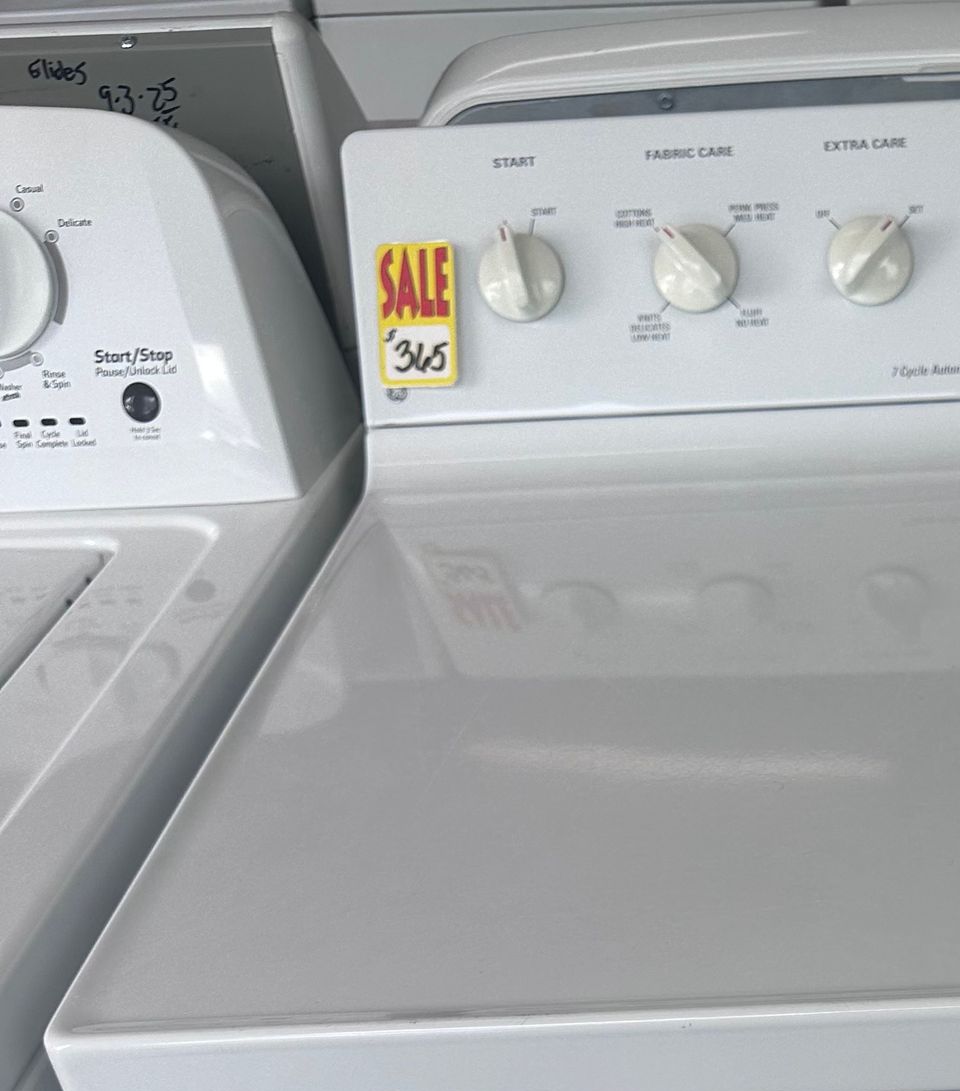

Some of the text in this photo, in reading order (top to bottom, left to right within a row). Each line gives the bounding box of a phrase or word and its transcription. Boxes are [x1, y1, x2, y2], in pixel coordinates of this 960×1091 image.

[823, 137, 908, 152] EXTRA CARE
[645, 146, 735, 161] FABRIC CARE
[493, 156, 536, 169] START
[16, 184, 44, 194] Casual
[531, 206, 557, 217] START
[57, 218, 93, 228] Delicate
[379, 246, 450, 320] SALE
[94, 347, 174, 366] Start/Stop
[42, 369, 66, 379] Rinse
[94, 364, 178, 379] Pause/Unlock Lid
[51, 380, 71, 391] Spin
